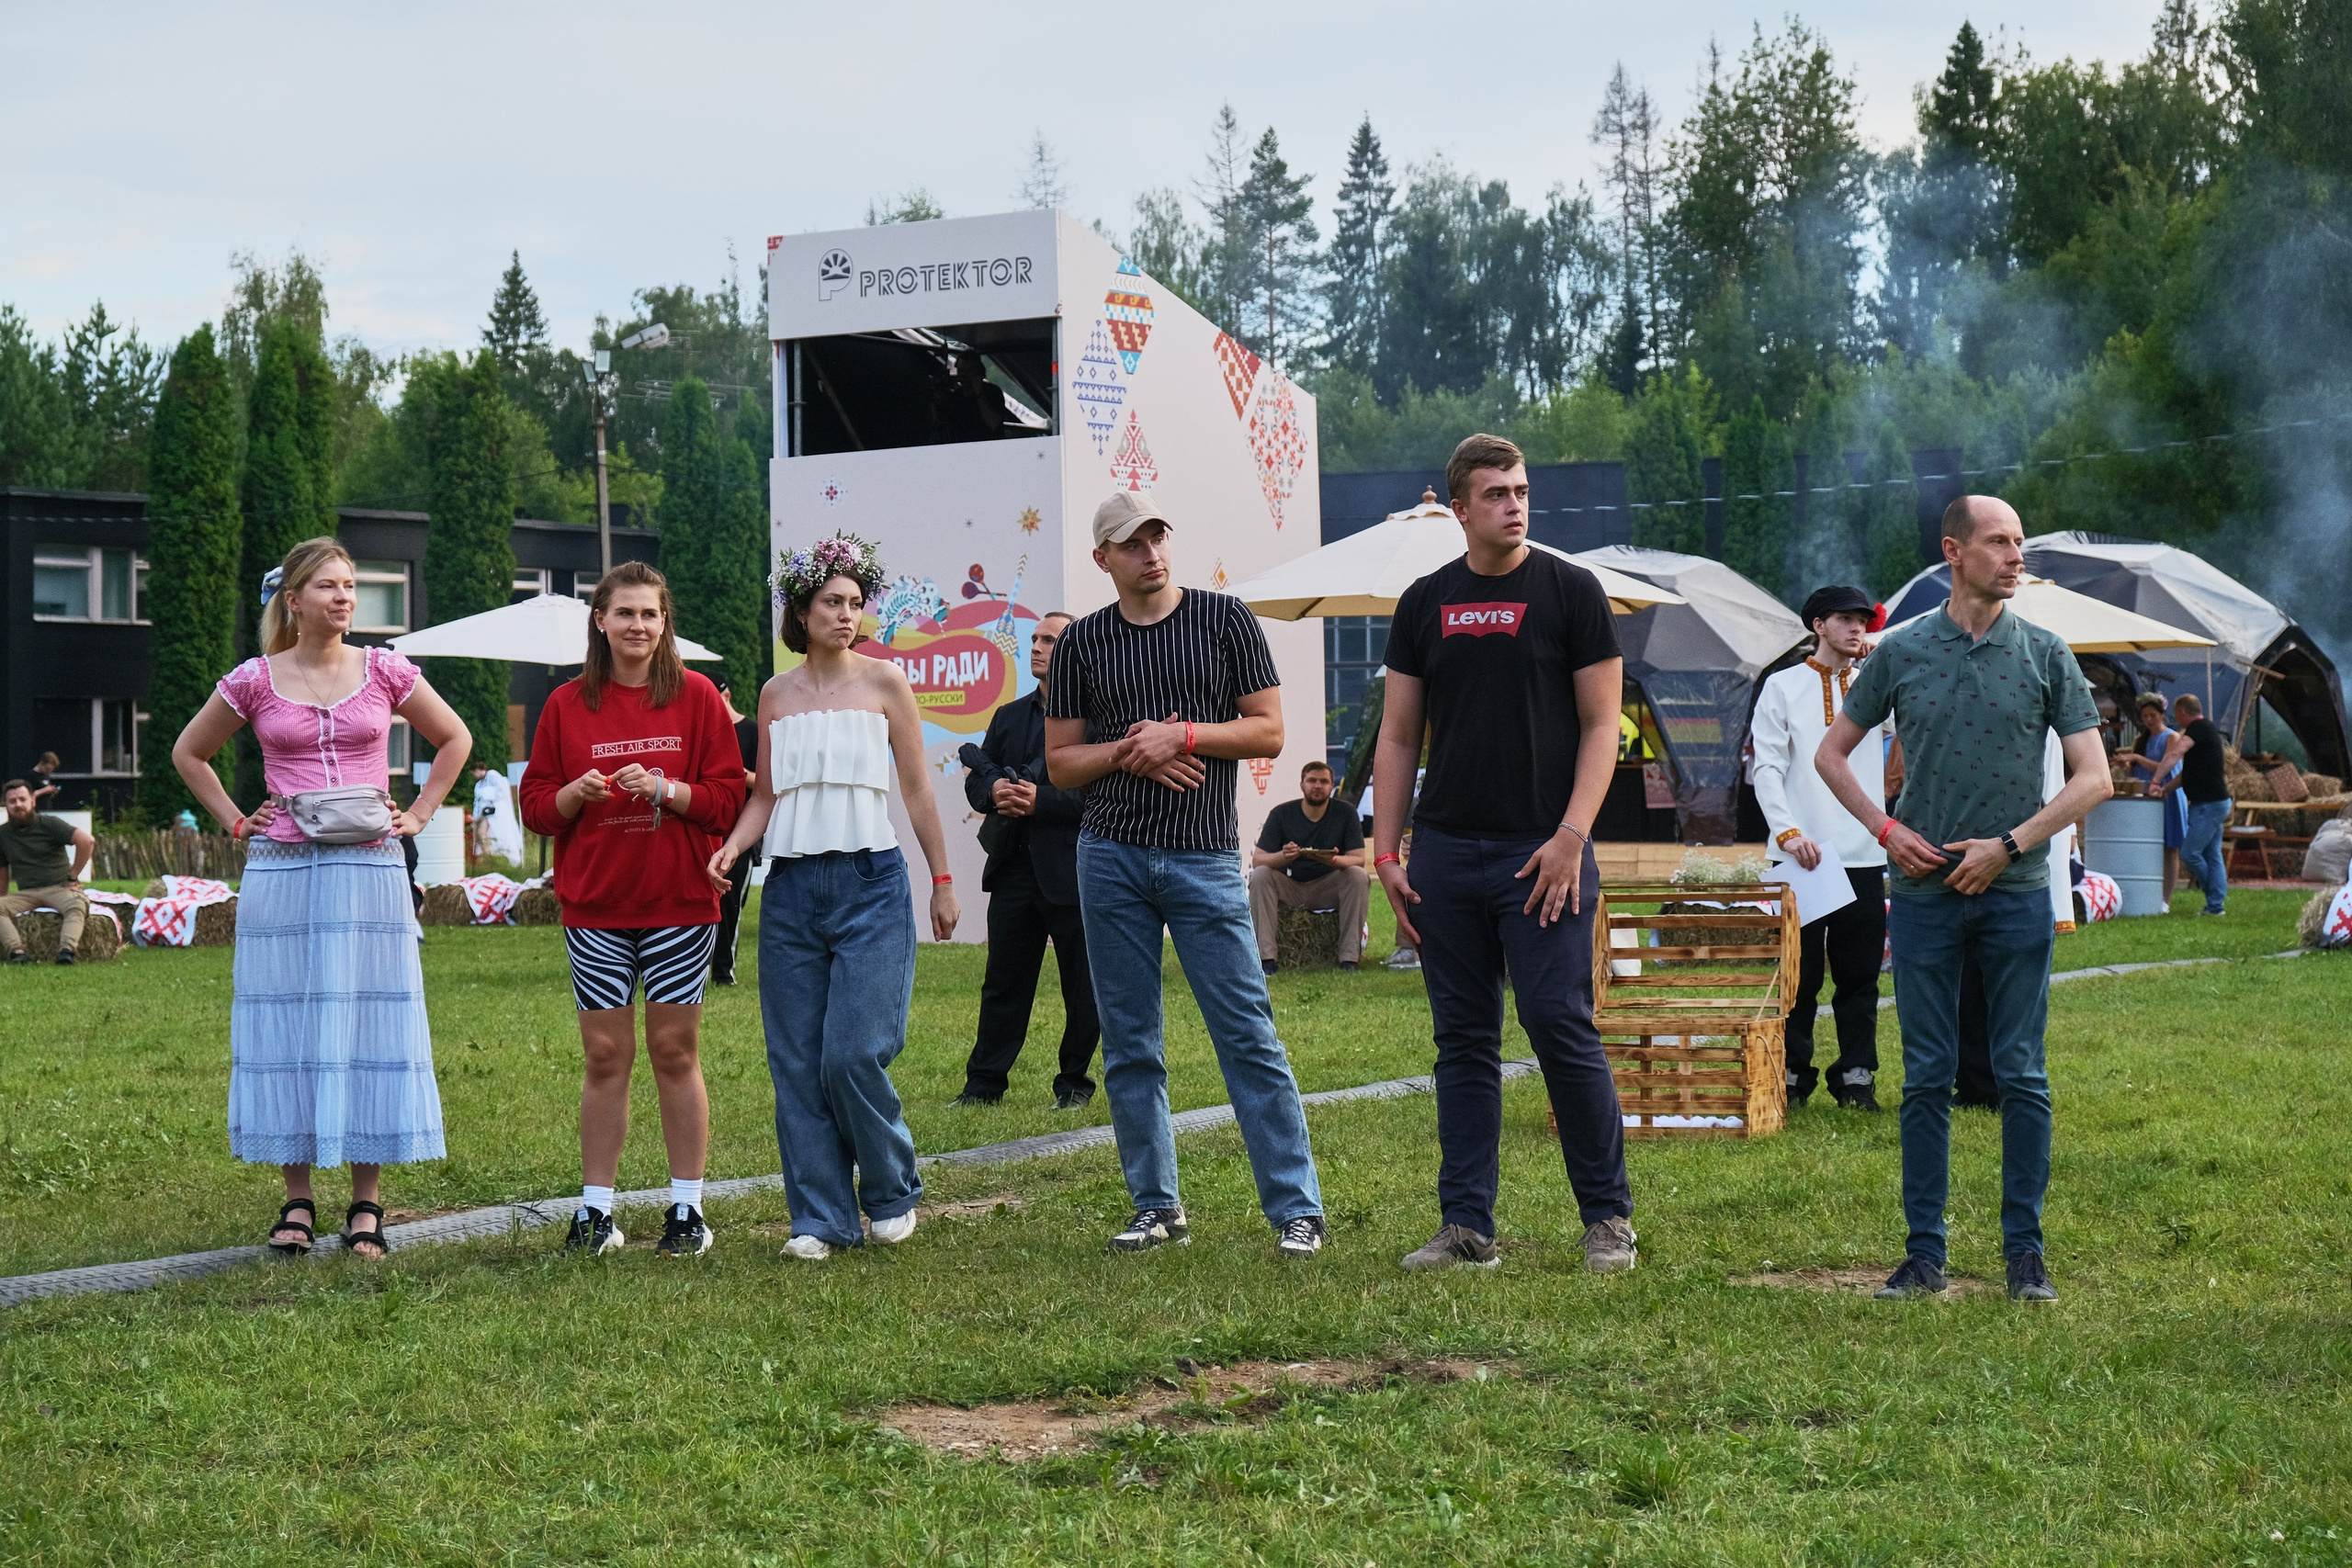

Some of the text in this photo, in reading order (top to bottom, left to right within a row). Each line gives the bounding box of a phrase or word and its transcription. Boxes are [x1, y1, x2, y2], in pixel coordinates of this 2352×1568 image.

[860, 256, 1032, 298] PROTEKTOR
[933, 650, 989, 688] РАДИ
[592, 739, 683, 756] FRESH AIR SPORT
